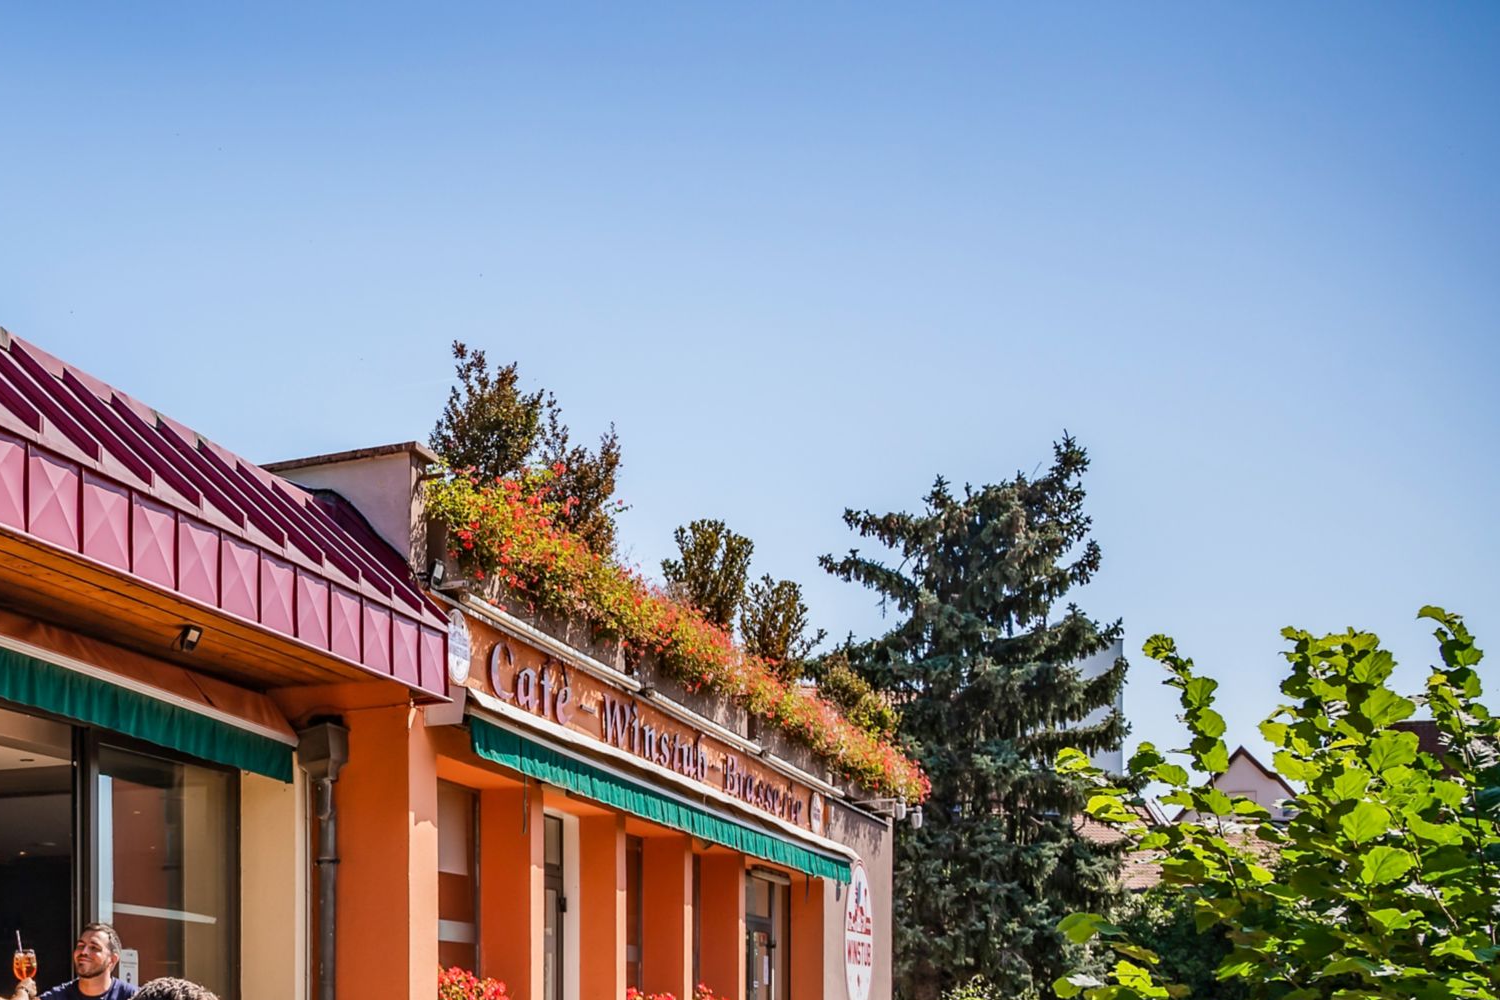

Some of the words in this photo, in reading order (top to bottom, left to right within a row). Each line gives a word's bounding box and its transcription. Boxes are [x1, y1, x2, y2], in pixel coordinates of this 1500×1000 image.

[489, 641, 573, 725] Café
[602, 693, 708, 784] Winstub
[847, 939, 871, 967] WINSTUB
